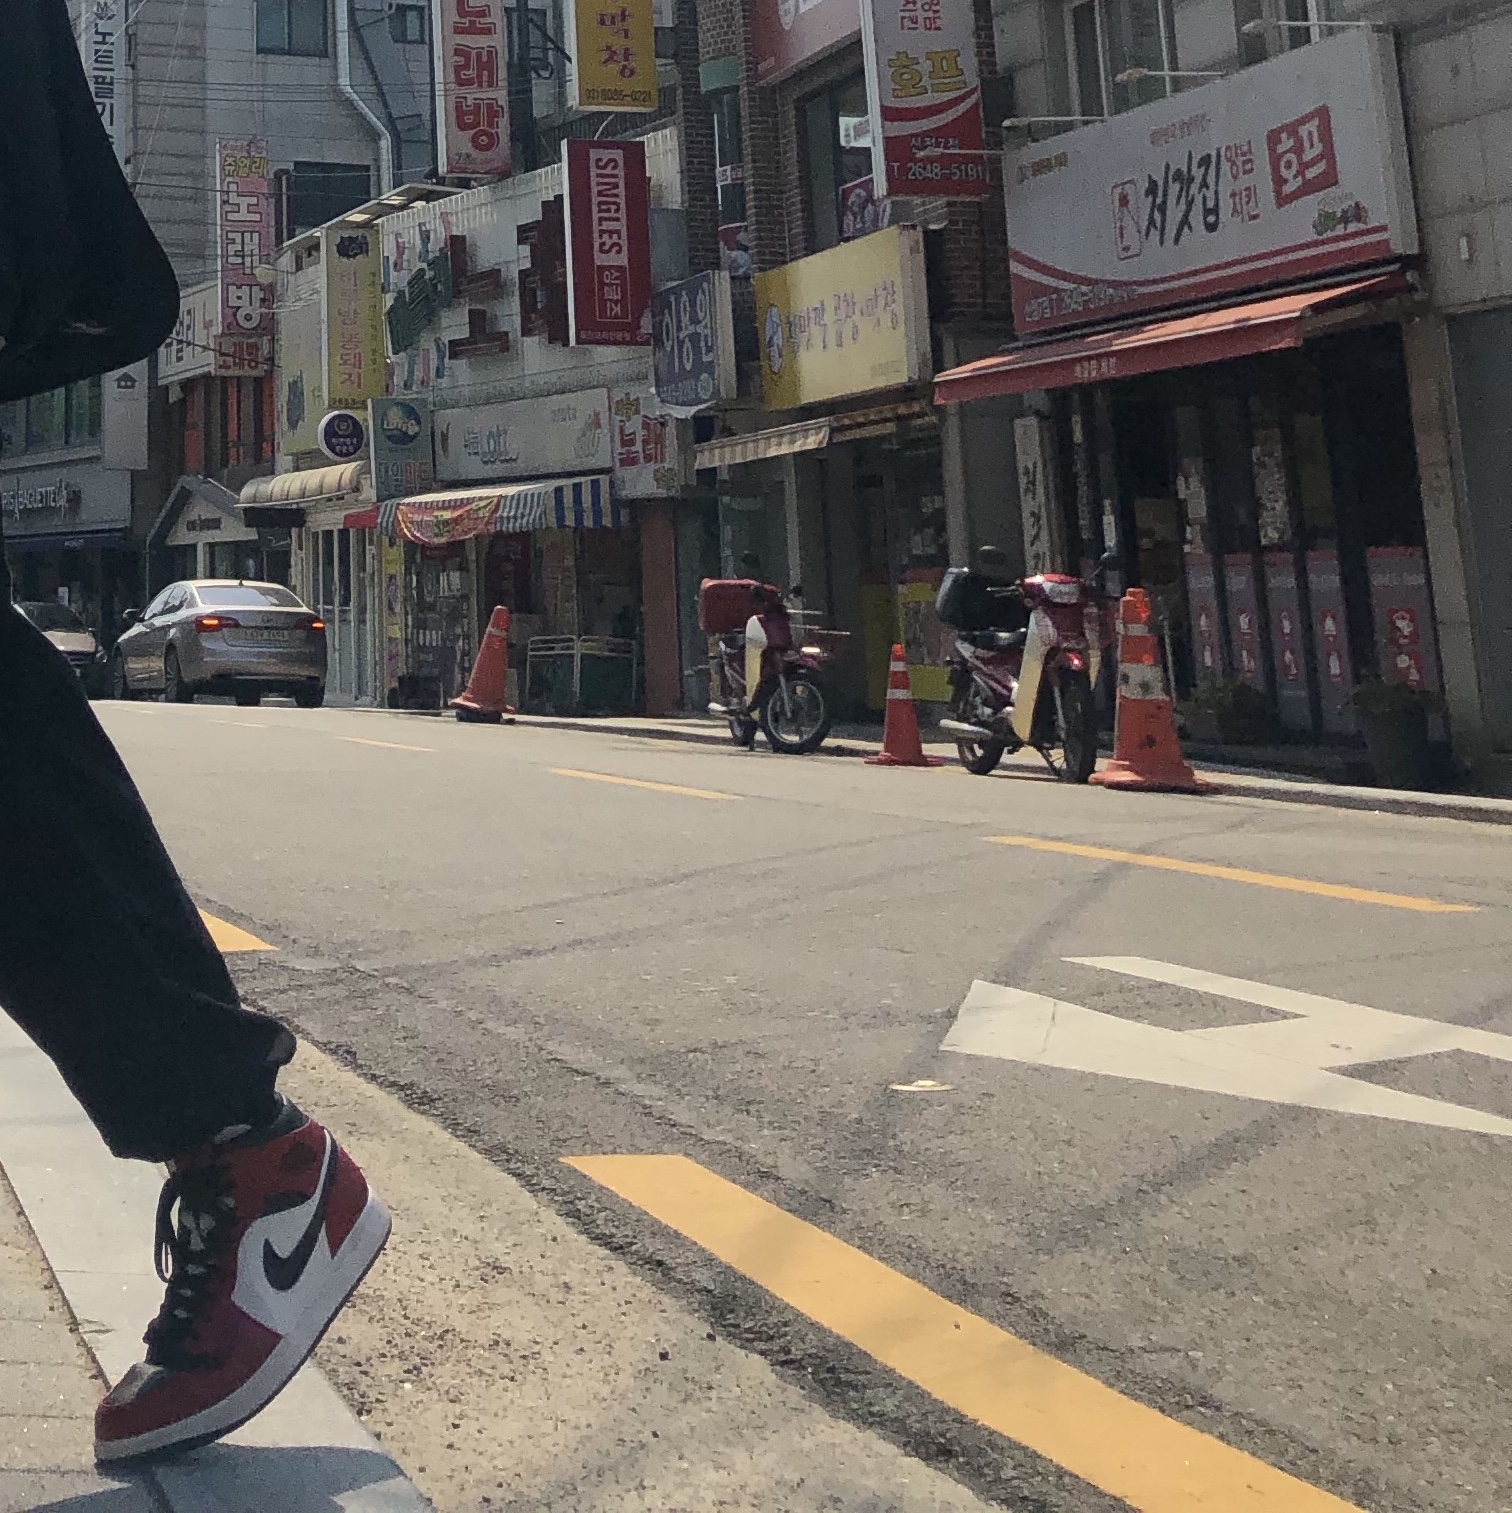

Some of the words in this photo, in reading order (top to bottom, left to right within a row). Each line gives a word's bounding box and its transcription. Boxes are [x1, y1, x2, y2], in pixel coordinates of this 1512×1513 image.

[887, 49, 968, 99] 호프
[1224, 139, 1255, 180] 양념
[1274, 116, 1328, 196] 호프
[595, 156, 625, 257] SINGLES
[1145, 146, 1221, 248] 처갓집
[1229, 188, 1260, 223] 치킨
[225, 181, 265, 330] 노래방
[218, 341, 260, 371] 노래방
